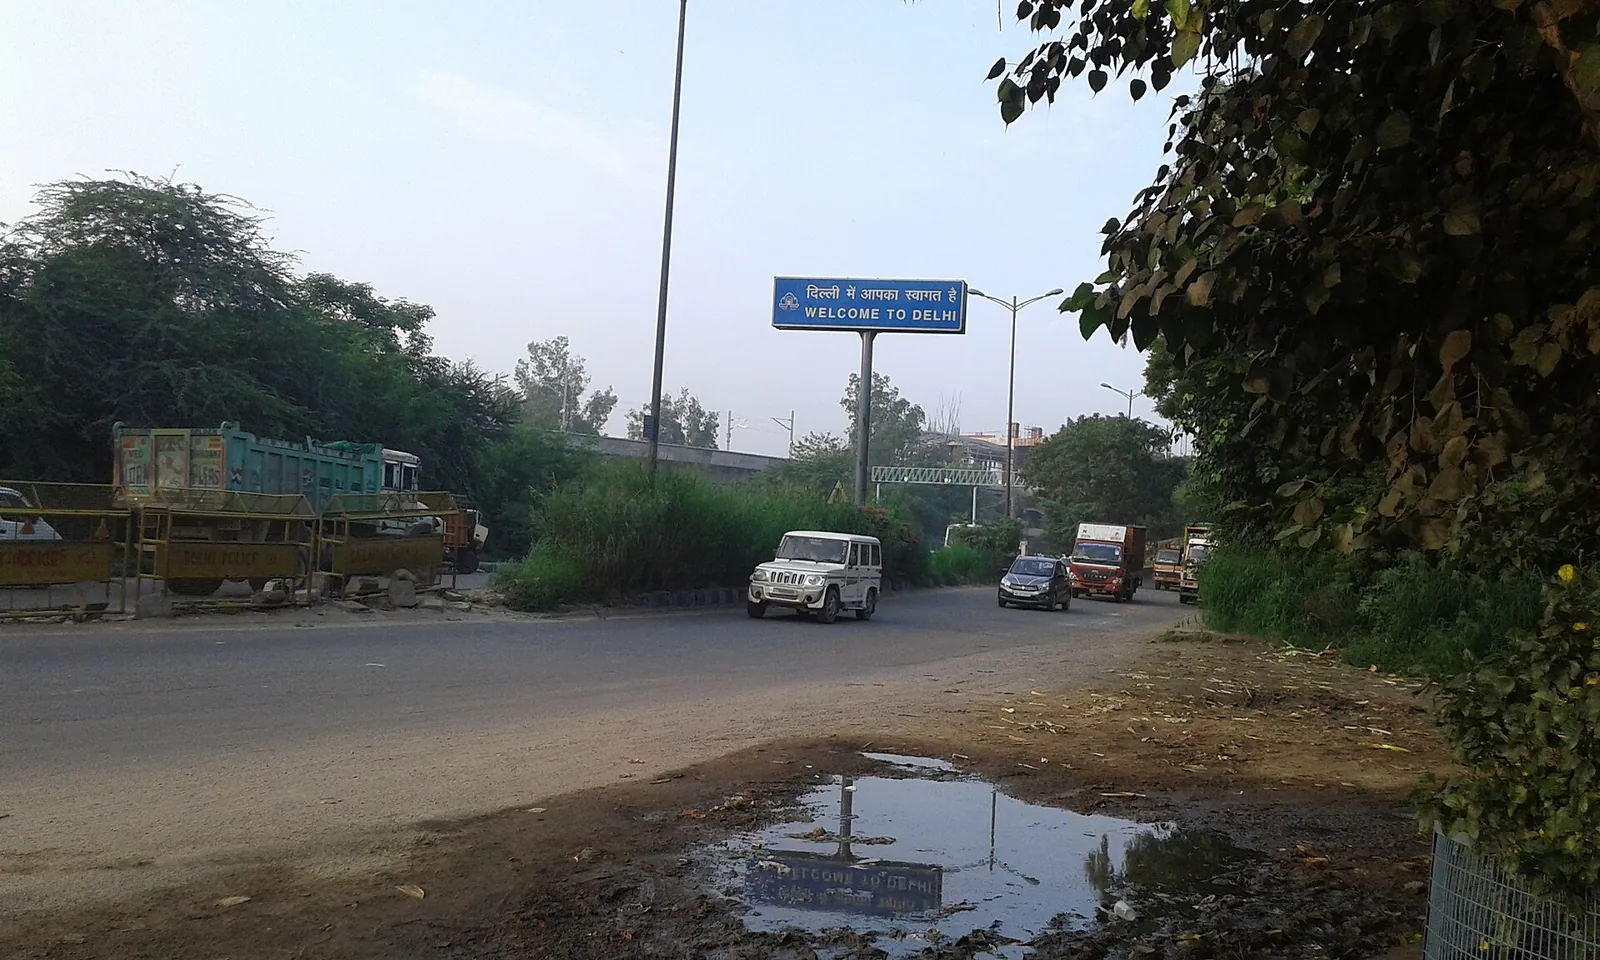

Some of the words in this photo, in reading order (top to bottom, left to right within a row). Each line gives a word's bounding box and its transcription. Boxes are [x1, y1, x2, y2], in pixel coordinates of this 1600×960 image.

[806, 284, 840, 300] दिल्ली
[846, 285, 856, 300] में
[860, 289, 899, 301] आपका
[904, 289, 942, 302] स्वागत
[947, 287, 957, 303] है
[805, 307, 880, 320] WELCOME
[886, 309, 906, 320] TO
[912, 309, 957, 322] DELHI
